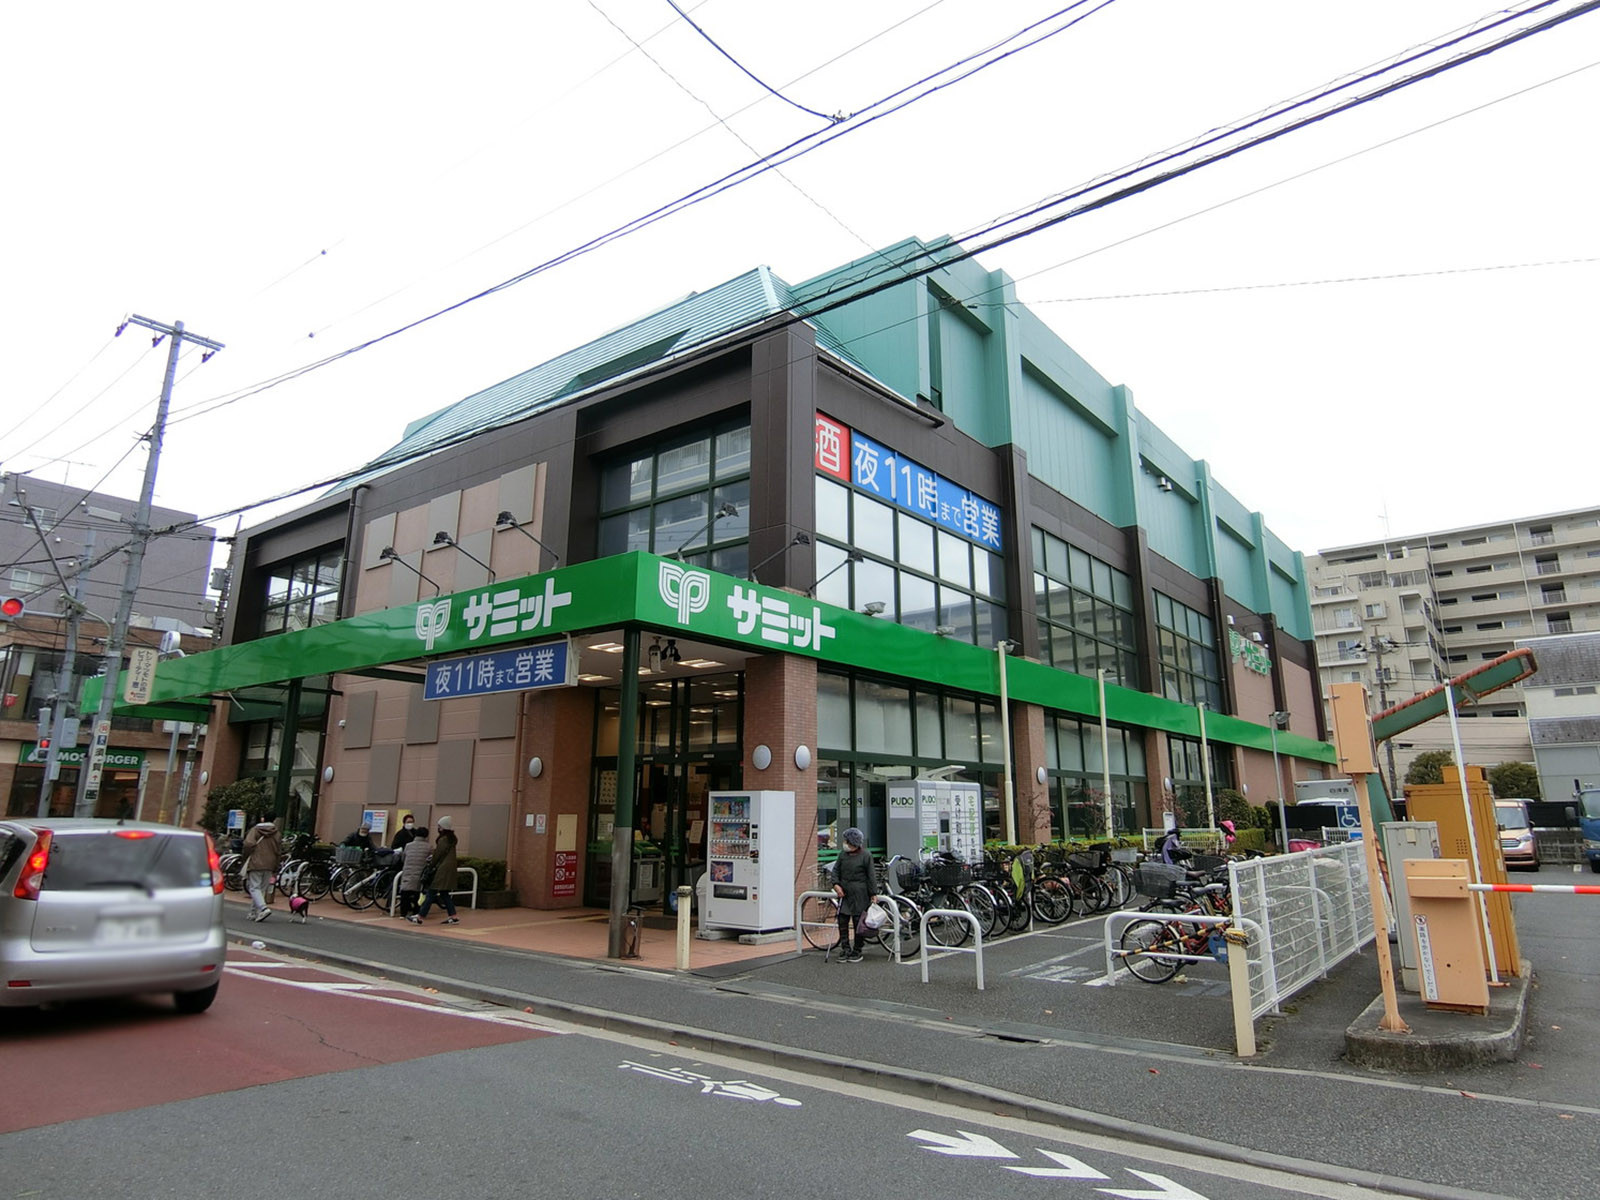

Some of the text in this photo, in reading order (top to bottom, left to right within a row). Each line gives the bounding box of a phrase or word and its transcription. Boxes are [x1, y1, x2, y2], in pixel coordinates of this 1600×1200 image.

[816, 418, 841, 472] 酒
[854, 440, 1000, 547] 夜11時まで営業
[463, 577, 573, 641] サミット
[727, 585, 836, 651] サミット
[435, 649, 554, 693] 夜11時まで営業
[891, 796, 914, 806] PUDO
[954, 795, 963, 853] 受け取れ
